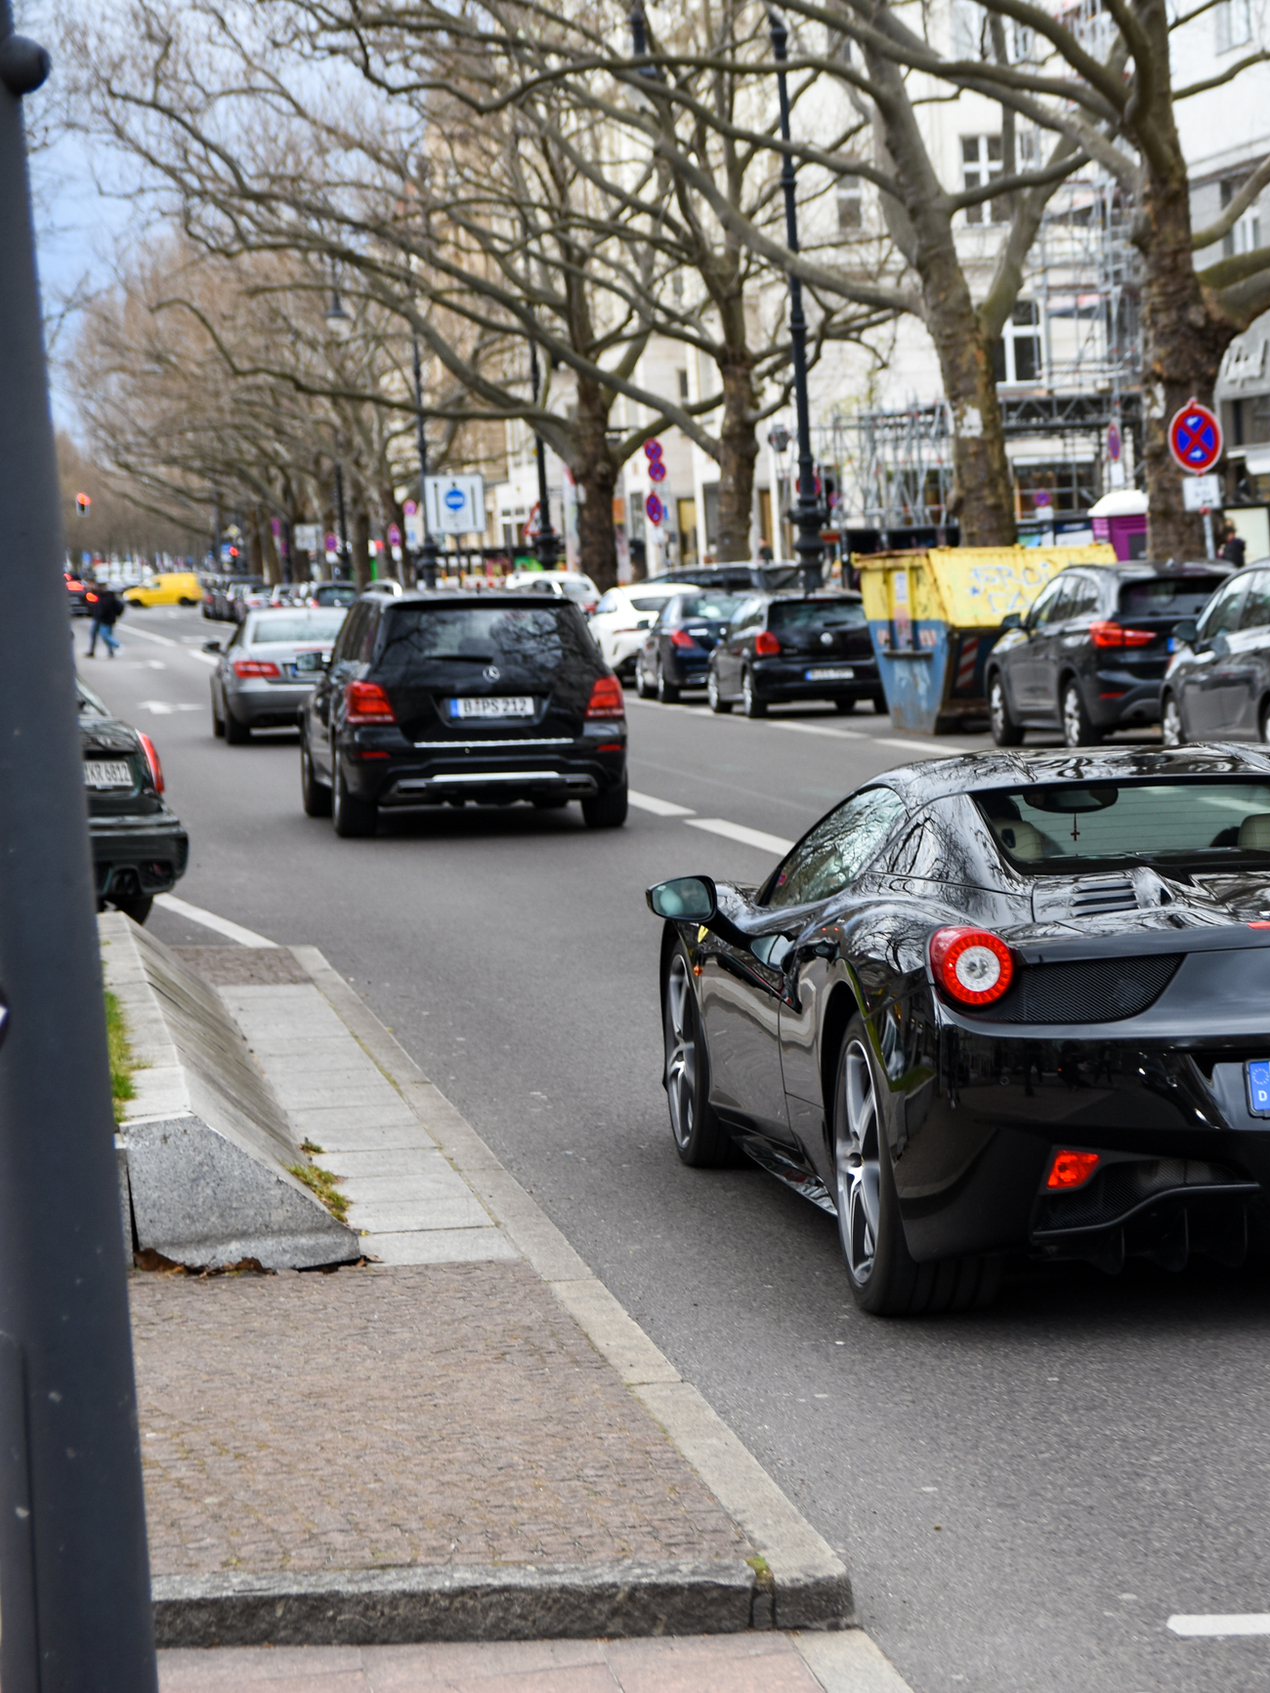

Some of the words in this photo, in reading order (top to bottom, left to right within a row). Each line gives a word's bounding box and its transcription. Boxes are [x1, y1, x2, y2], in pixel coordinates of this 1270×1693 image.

[482, 698, 499, 712] PS
[502, 697, 527, 711] 212
[1258, 1089, 1268, 1101] D
